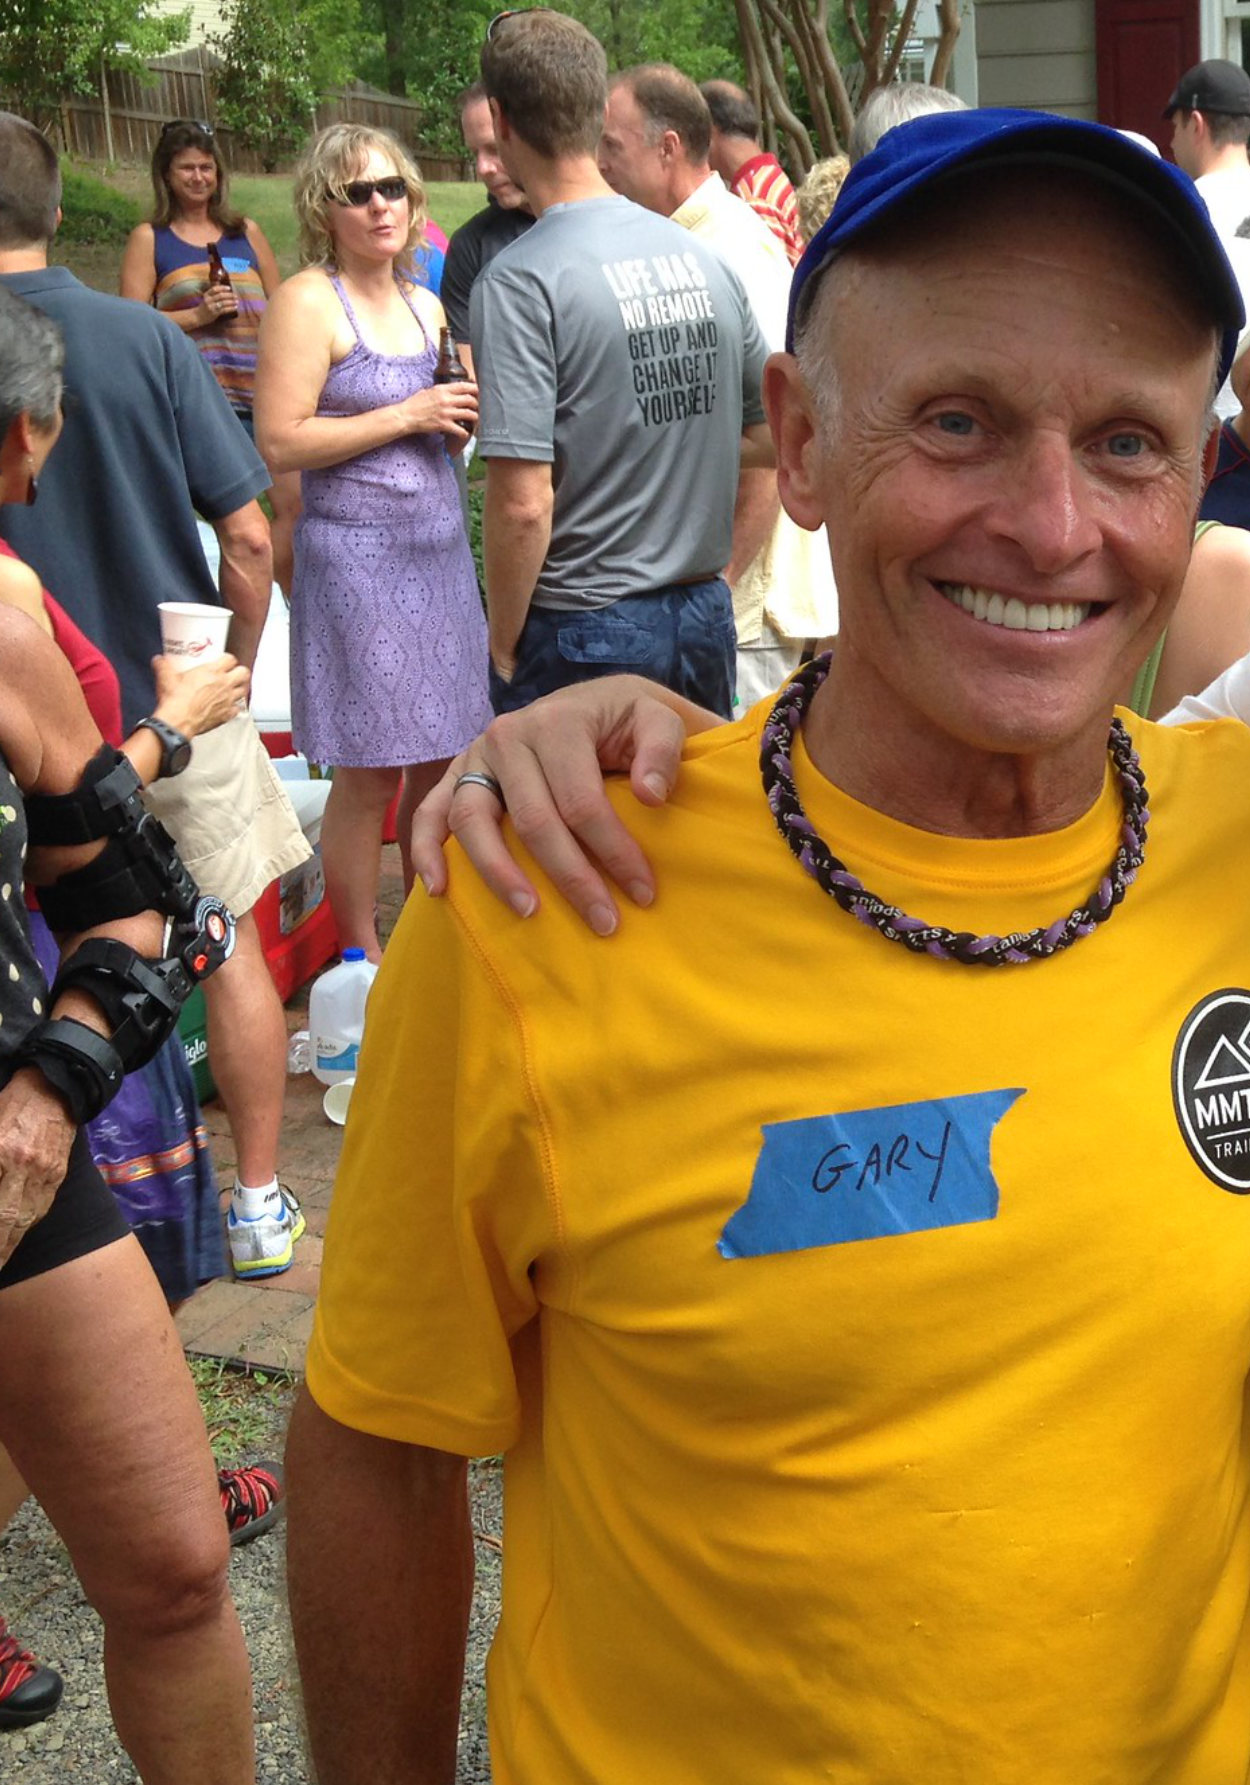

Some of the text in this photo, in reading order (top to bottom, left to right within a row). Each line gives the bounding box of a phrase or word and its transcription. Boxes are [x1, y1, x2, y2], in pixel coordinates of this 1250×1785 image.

[601, 251, 707, 299] LIFE HAS
[618, 290, 715, 330] NO REMOTE
[628, 321, 718, 361] GET UP AND
[632, 352, 718, 394] CHANGE IT
[636, 384, 716, 427] YOURSELF
[184, 1038, 207, 1062] iglo
[812, 1121, 951, 1203] GARY
